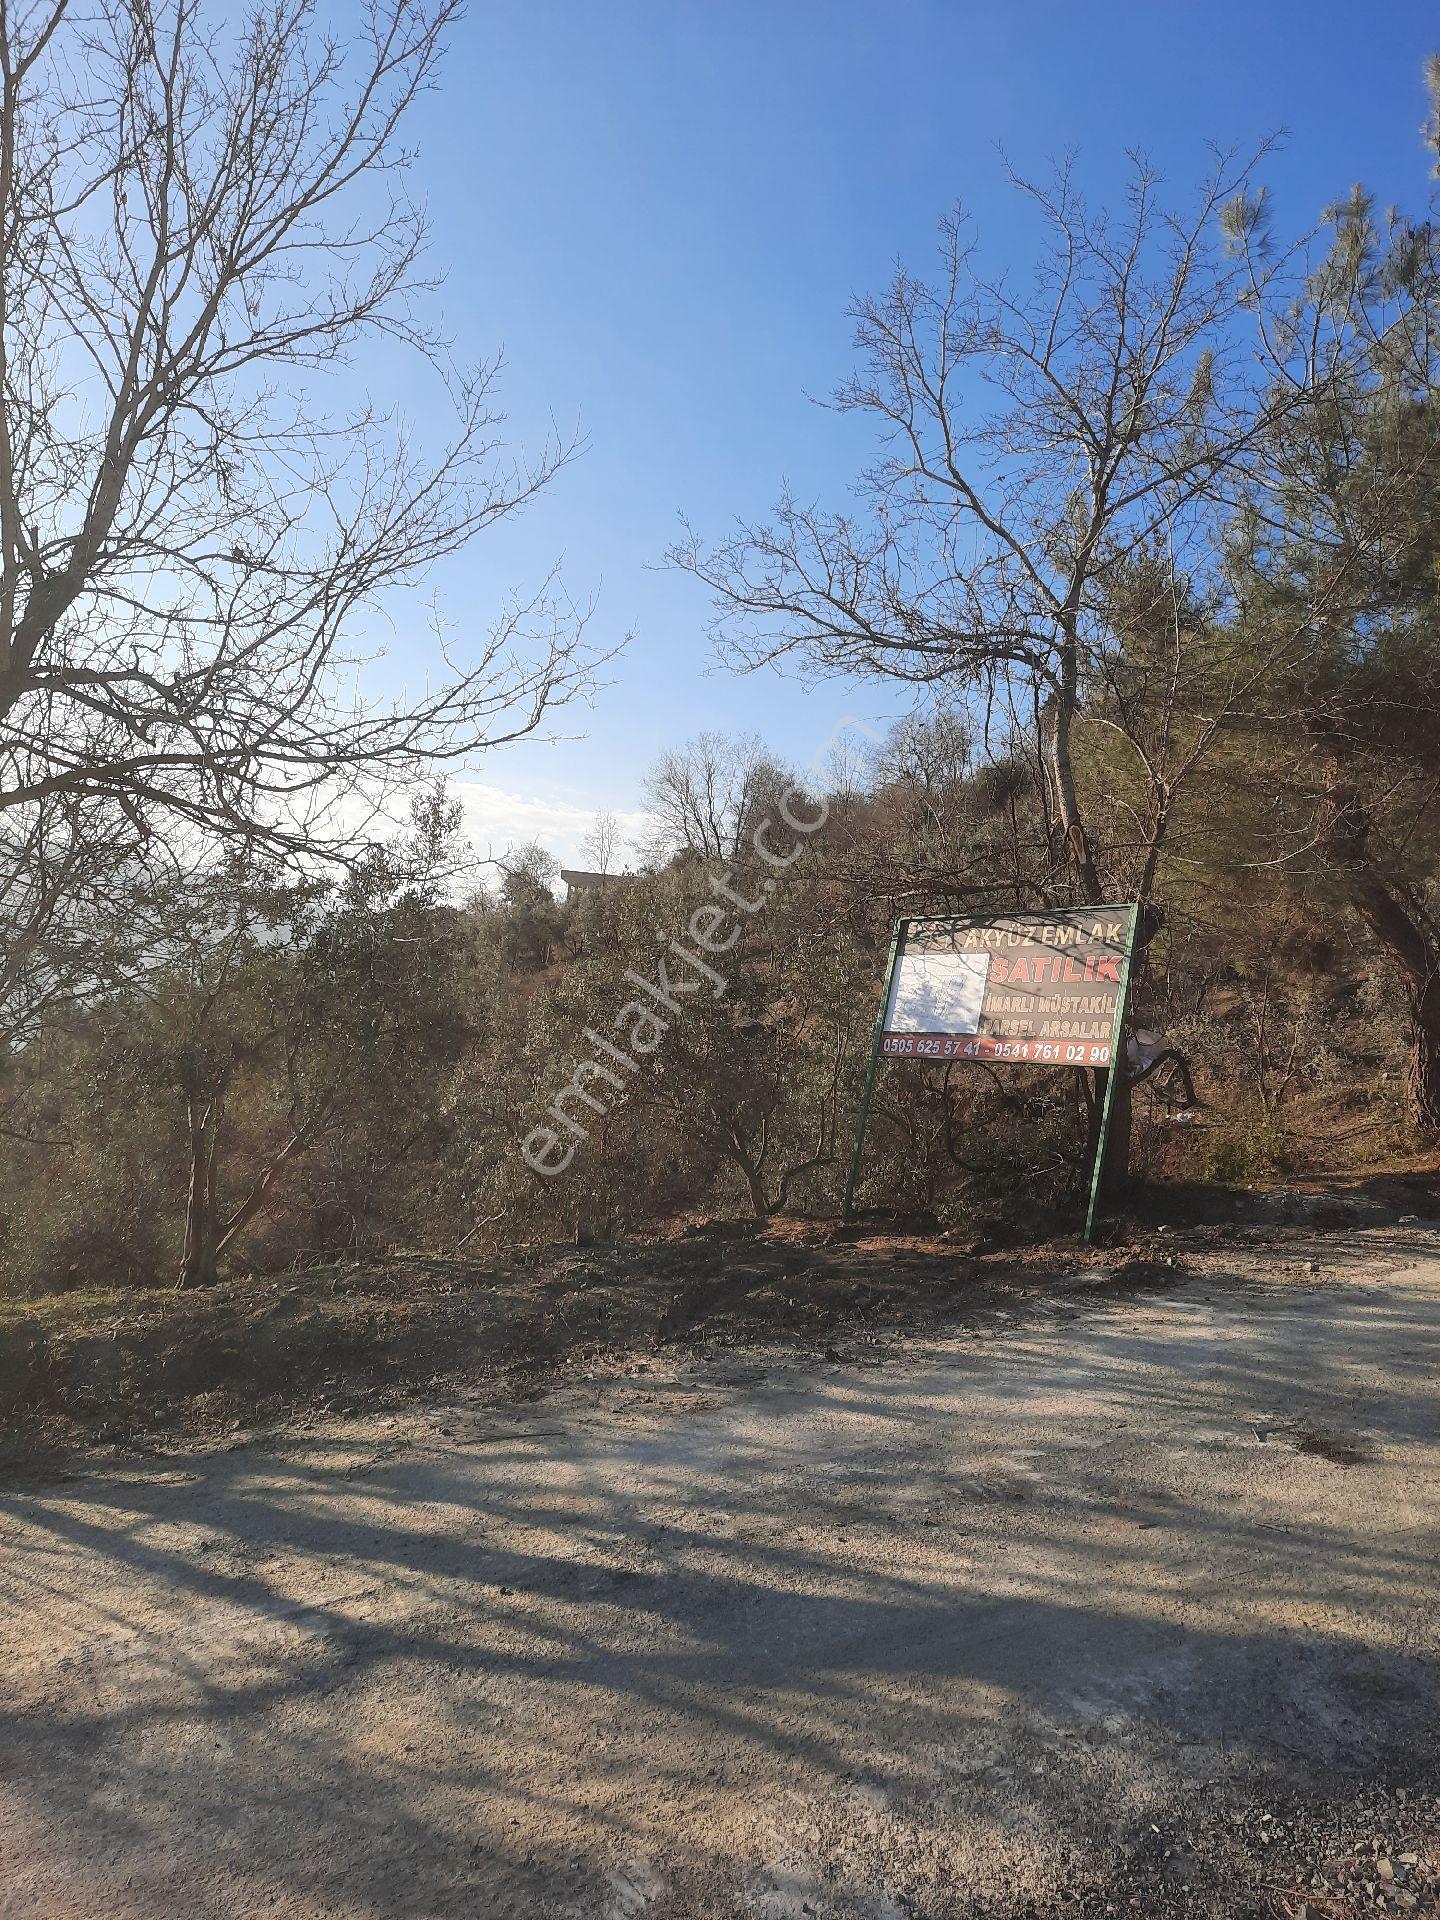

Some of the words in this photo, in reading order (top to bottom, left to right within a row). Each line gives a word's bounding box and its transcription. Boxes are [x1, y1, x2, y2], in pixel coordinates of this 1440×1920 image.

[963, 923, 1037, 948] AKYÜZ
[1042, 923, 1123, 946] EMLAK
[989, 956, 1125, 983] SATILIK
[985, 992, 1034, 1013] İMARLI
[1038, 993, 1116, 1014] MÜSTAKİL
[983, 1019, 1036, 1037] PARSEL
[1039, 1020, 1112, 1039] ARSALAR
[883, 1039, 913, 1053] 0505
[917, 1040, 940, 1054] 625
[943, 1041, 961, 1055] 57
[964, 1041, 980, 1056] 41
[994, 1043, 1028, 1058] 0541
[1033, 1043, 1060, 1059] 761
[1066, 1045, 1085, 1061] 02
[1089, 1046, 1111, 1062] 90
